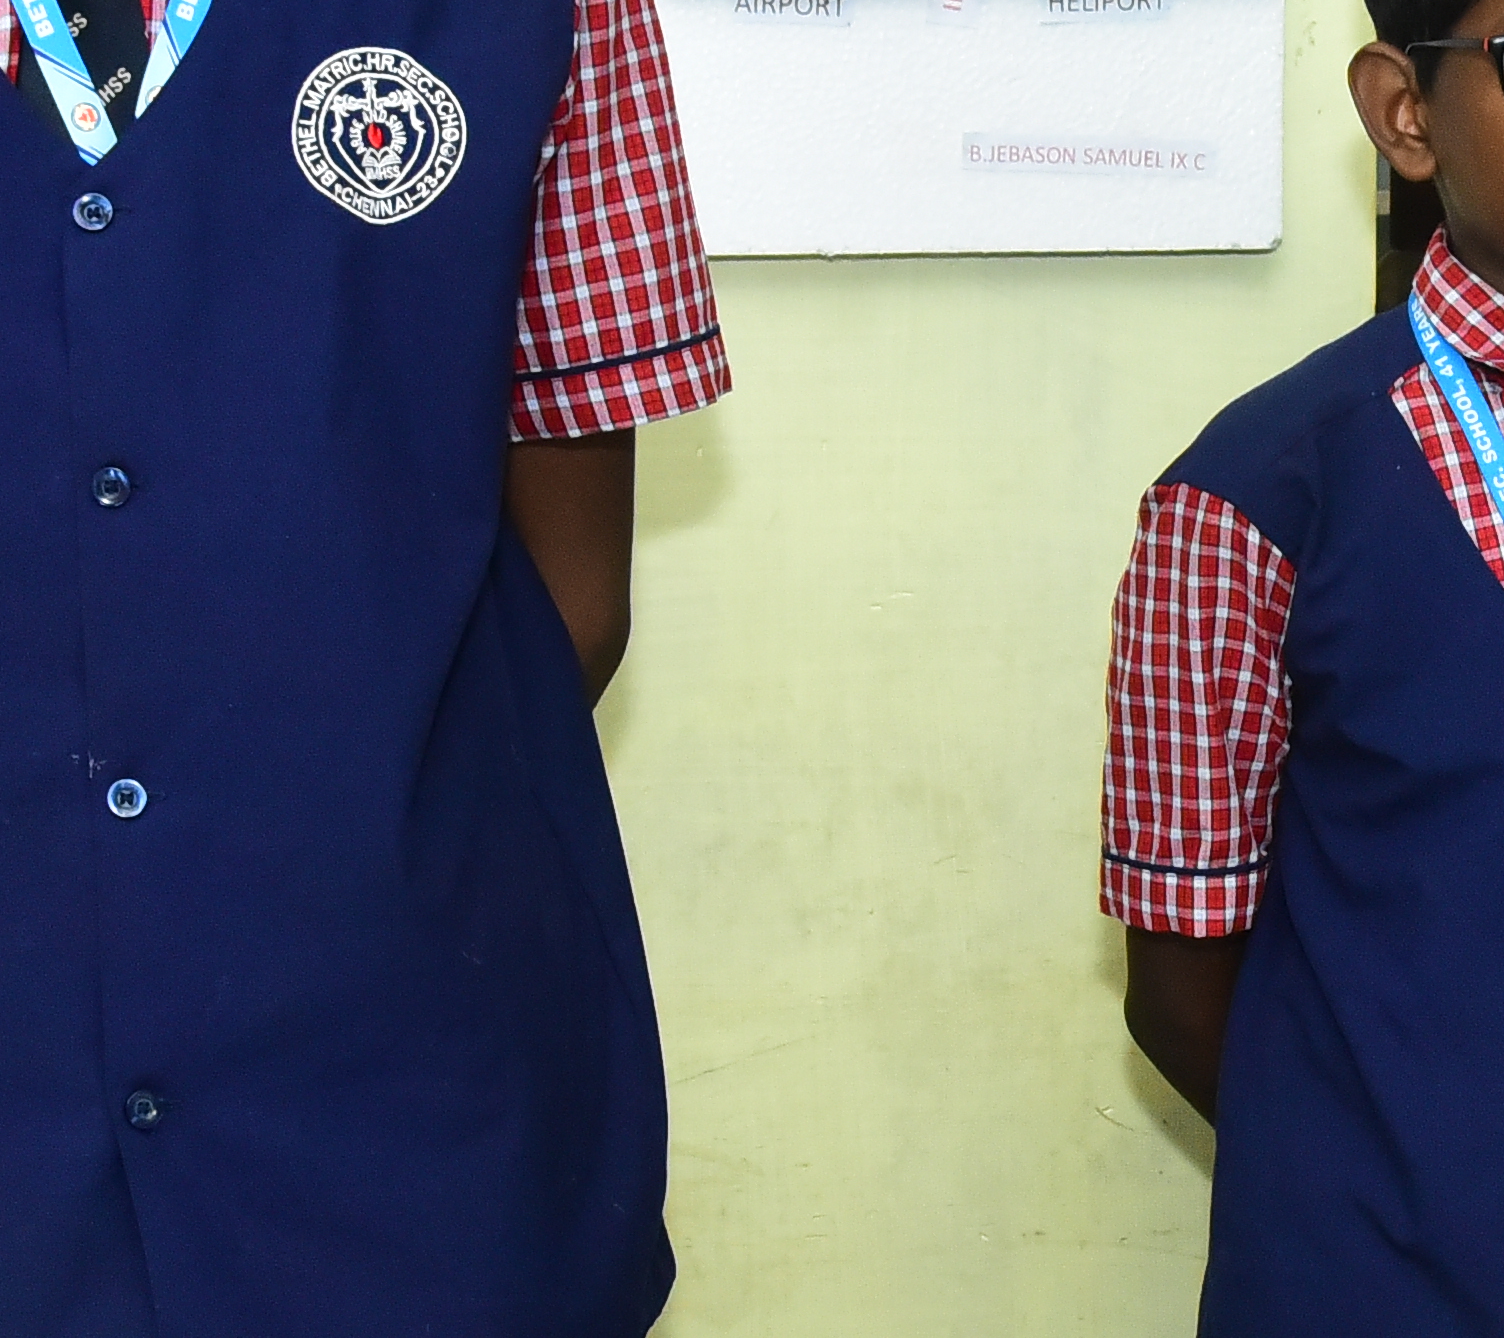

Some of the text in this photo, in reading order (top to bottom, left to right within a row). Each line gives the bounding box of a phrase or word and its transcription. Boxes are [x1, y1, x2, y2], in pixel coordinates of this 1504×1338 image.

[969, 144, 1207, 171] B.JEBASON SAMUEL IX C
[1434, 356, 1454, 377] 41
